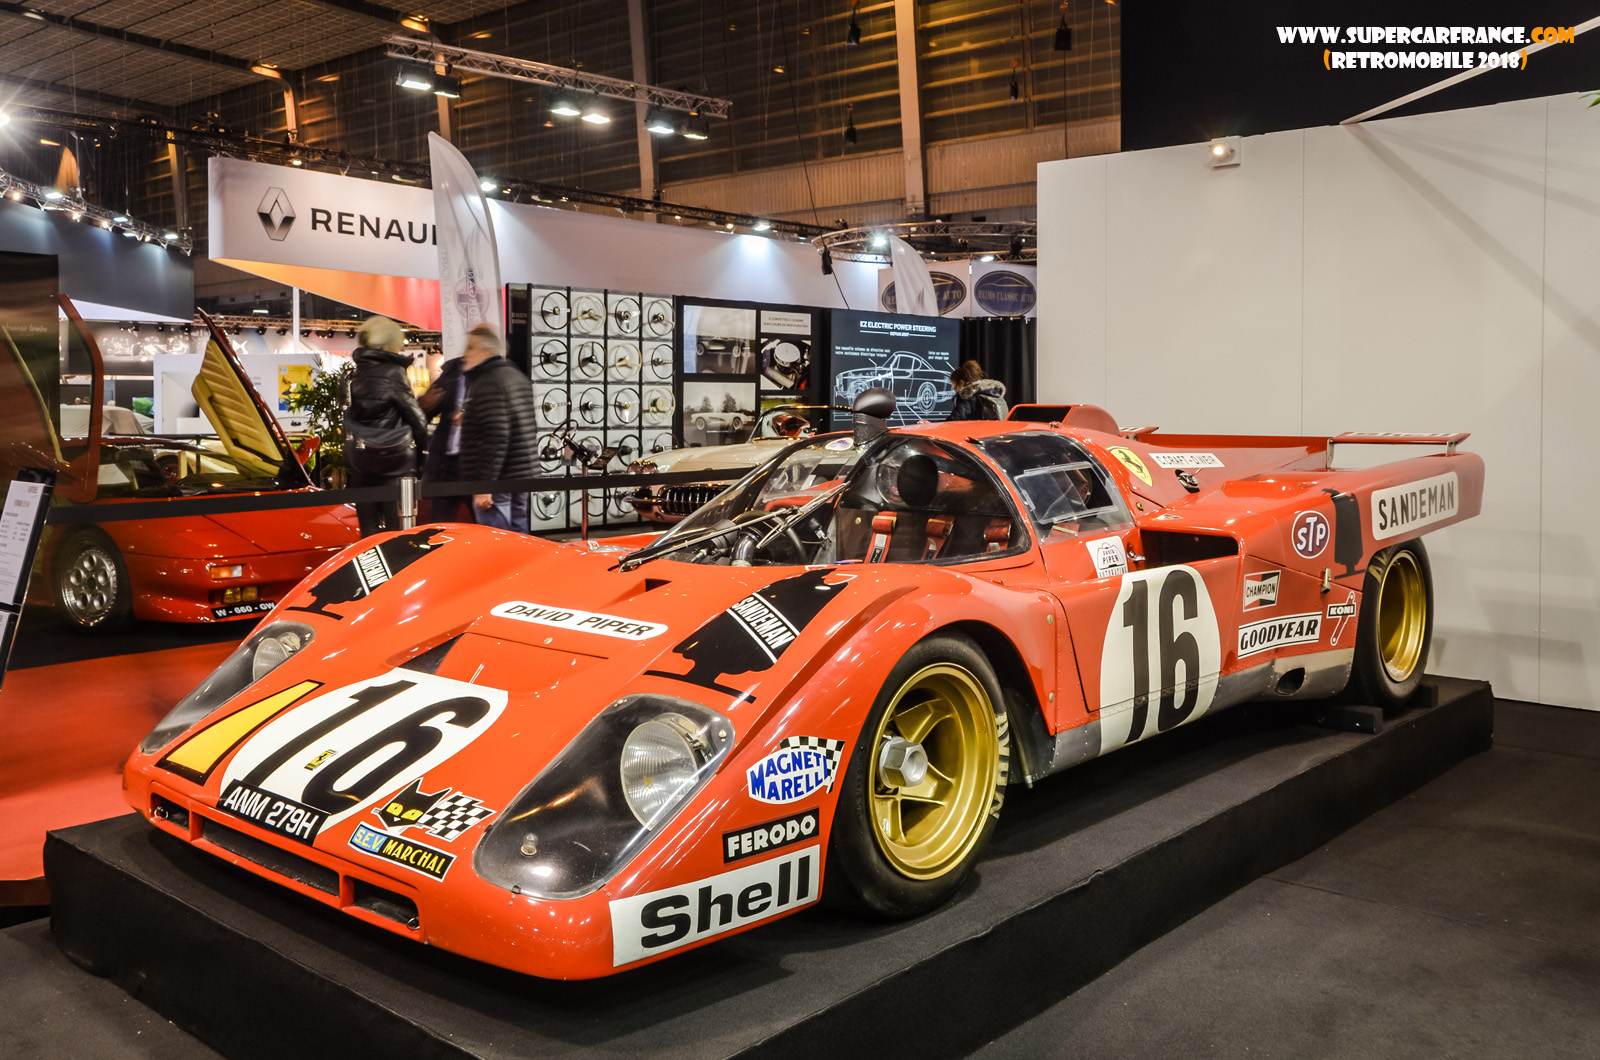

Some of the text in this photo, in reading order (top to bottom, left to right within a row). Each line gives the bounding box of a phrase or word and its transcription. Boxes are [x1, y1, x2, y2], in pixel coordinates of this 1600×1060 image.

[860, 320, 937, 333] EZ ELECTRIC POWER STEERING
[1379, 488, 1455, 531] SANDEMAN
[1297, 514, 1327, 554] STP
[357, 548, 389, 588] SANDEMAN
[1102, 555, 1119, 564] PIPER
[1246, 583, 1276, 598] CHAMPION
[1330, 605, 1354, 615] KONI
[504, 604, 654, 636] DAVID PIPER
[731, 596, 796, 650] SANDEMAN
[1240, 619, 1318, 650] GOODYEAR
[1123, 569, 1200, 745] 16
[242, 679, 490, 814] 16
[750, 751, 828, 788] MAGNETI
[223, 786, 319, 839] ANM 279H
[728, 815, 816, 858] FERODO
[382, 840, 446, 875] MARCHAL
[640, 854, 811, 949] Shell
